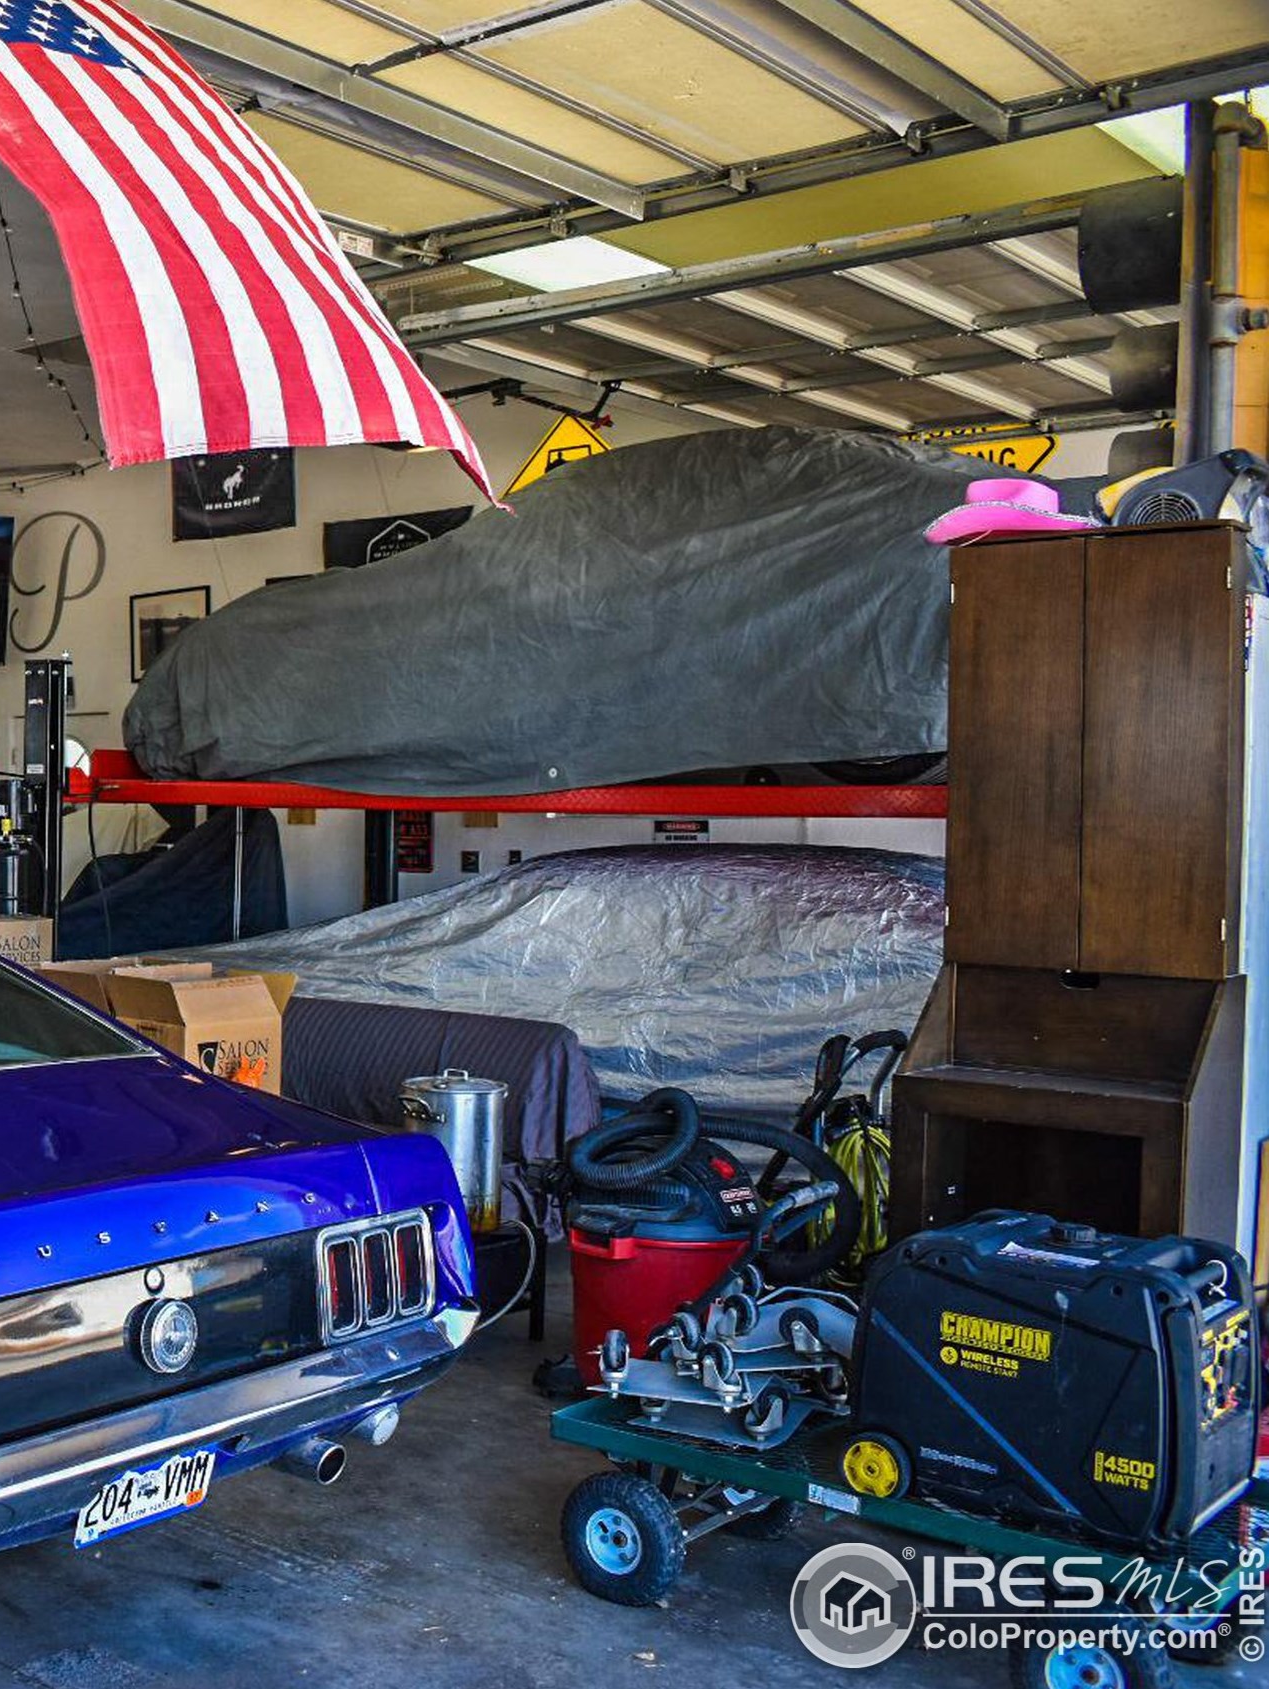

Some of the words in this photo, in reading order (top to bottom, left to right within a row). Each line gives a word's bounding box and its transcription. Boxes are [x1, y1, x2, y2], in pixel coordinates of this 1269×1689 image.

[218, 1039, 268, 1060] SALON
[941, 1311, 1051, 1356] CHAMPION
[960, 1349, 1019, 1371] WIRELESS
[960, 1360, 991, 1374] REMOTE
[993, 1369, 1018, 1379] START
[1104, 1456, 1155, 1480] 4500
[84, 1477, 134, 1528] 204
[164, 1454, 209, 1501] VMM
[1104, 1471, 1149, 1491] WATTS
